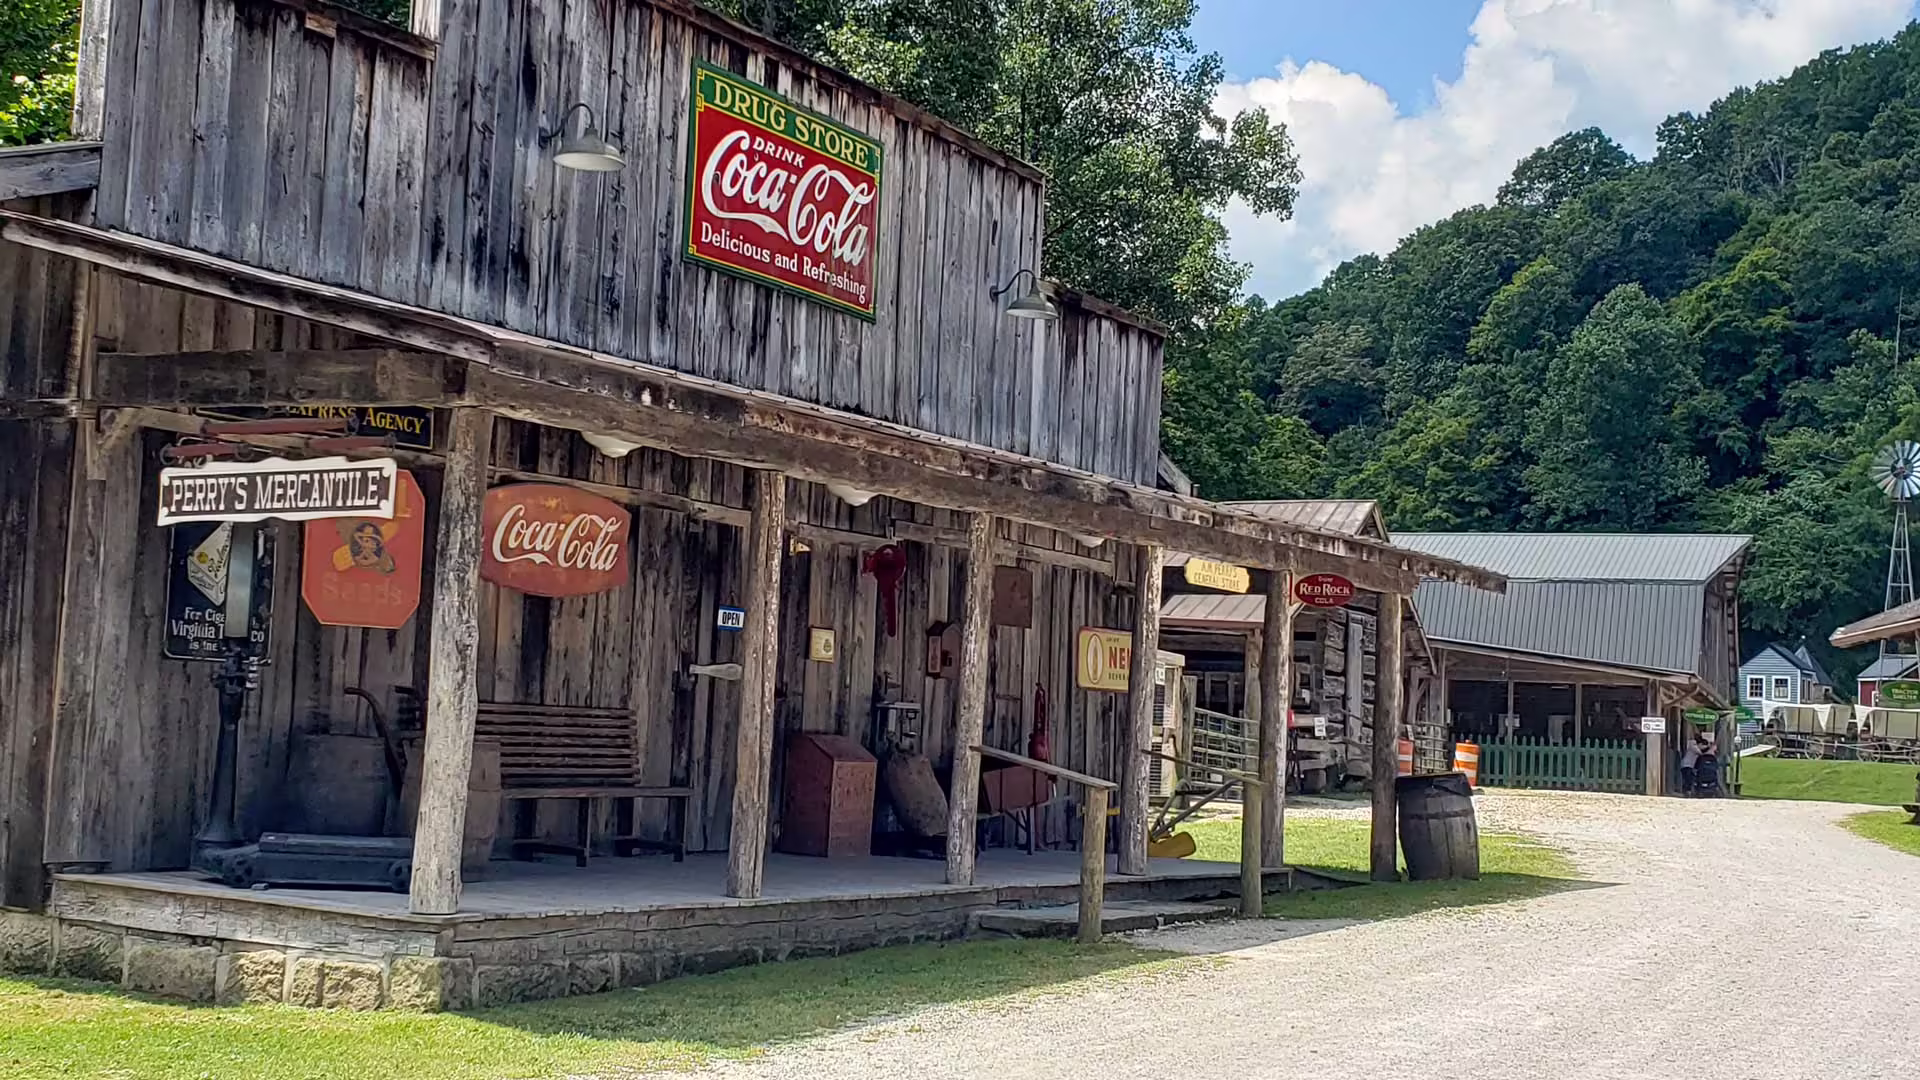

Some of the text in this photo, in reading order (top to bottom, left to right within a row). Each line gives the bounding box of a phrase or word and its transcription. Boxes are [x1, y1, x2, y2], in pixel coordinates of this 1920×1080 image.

[714, 79, 868, 168] DRUG STORE
[752, 136, 806, 168] DRINK
[702, 130, 876, 266] Coca-Cola
[701, 221, 867, 304] Delicious and Refreshing
[362, 407, 425, 435] AGENCY
[170, 476, 249, 513] PERRY'S
[253, 470, 380, 510] MERCANTILE
[492, 504, 623, 571] Coca-Cola
[1299, 583, 1350, 596] RED ROCK
[171, 618, 217, 640] Virginia
[721, 611, 741, 626] OPEN
